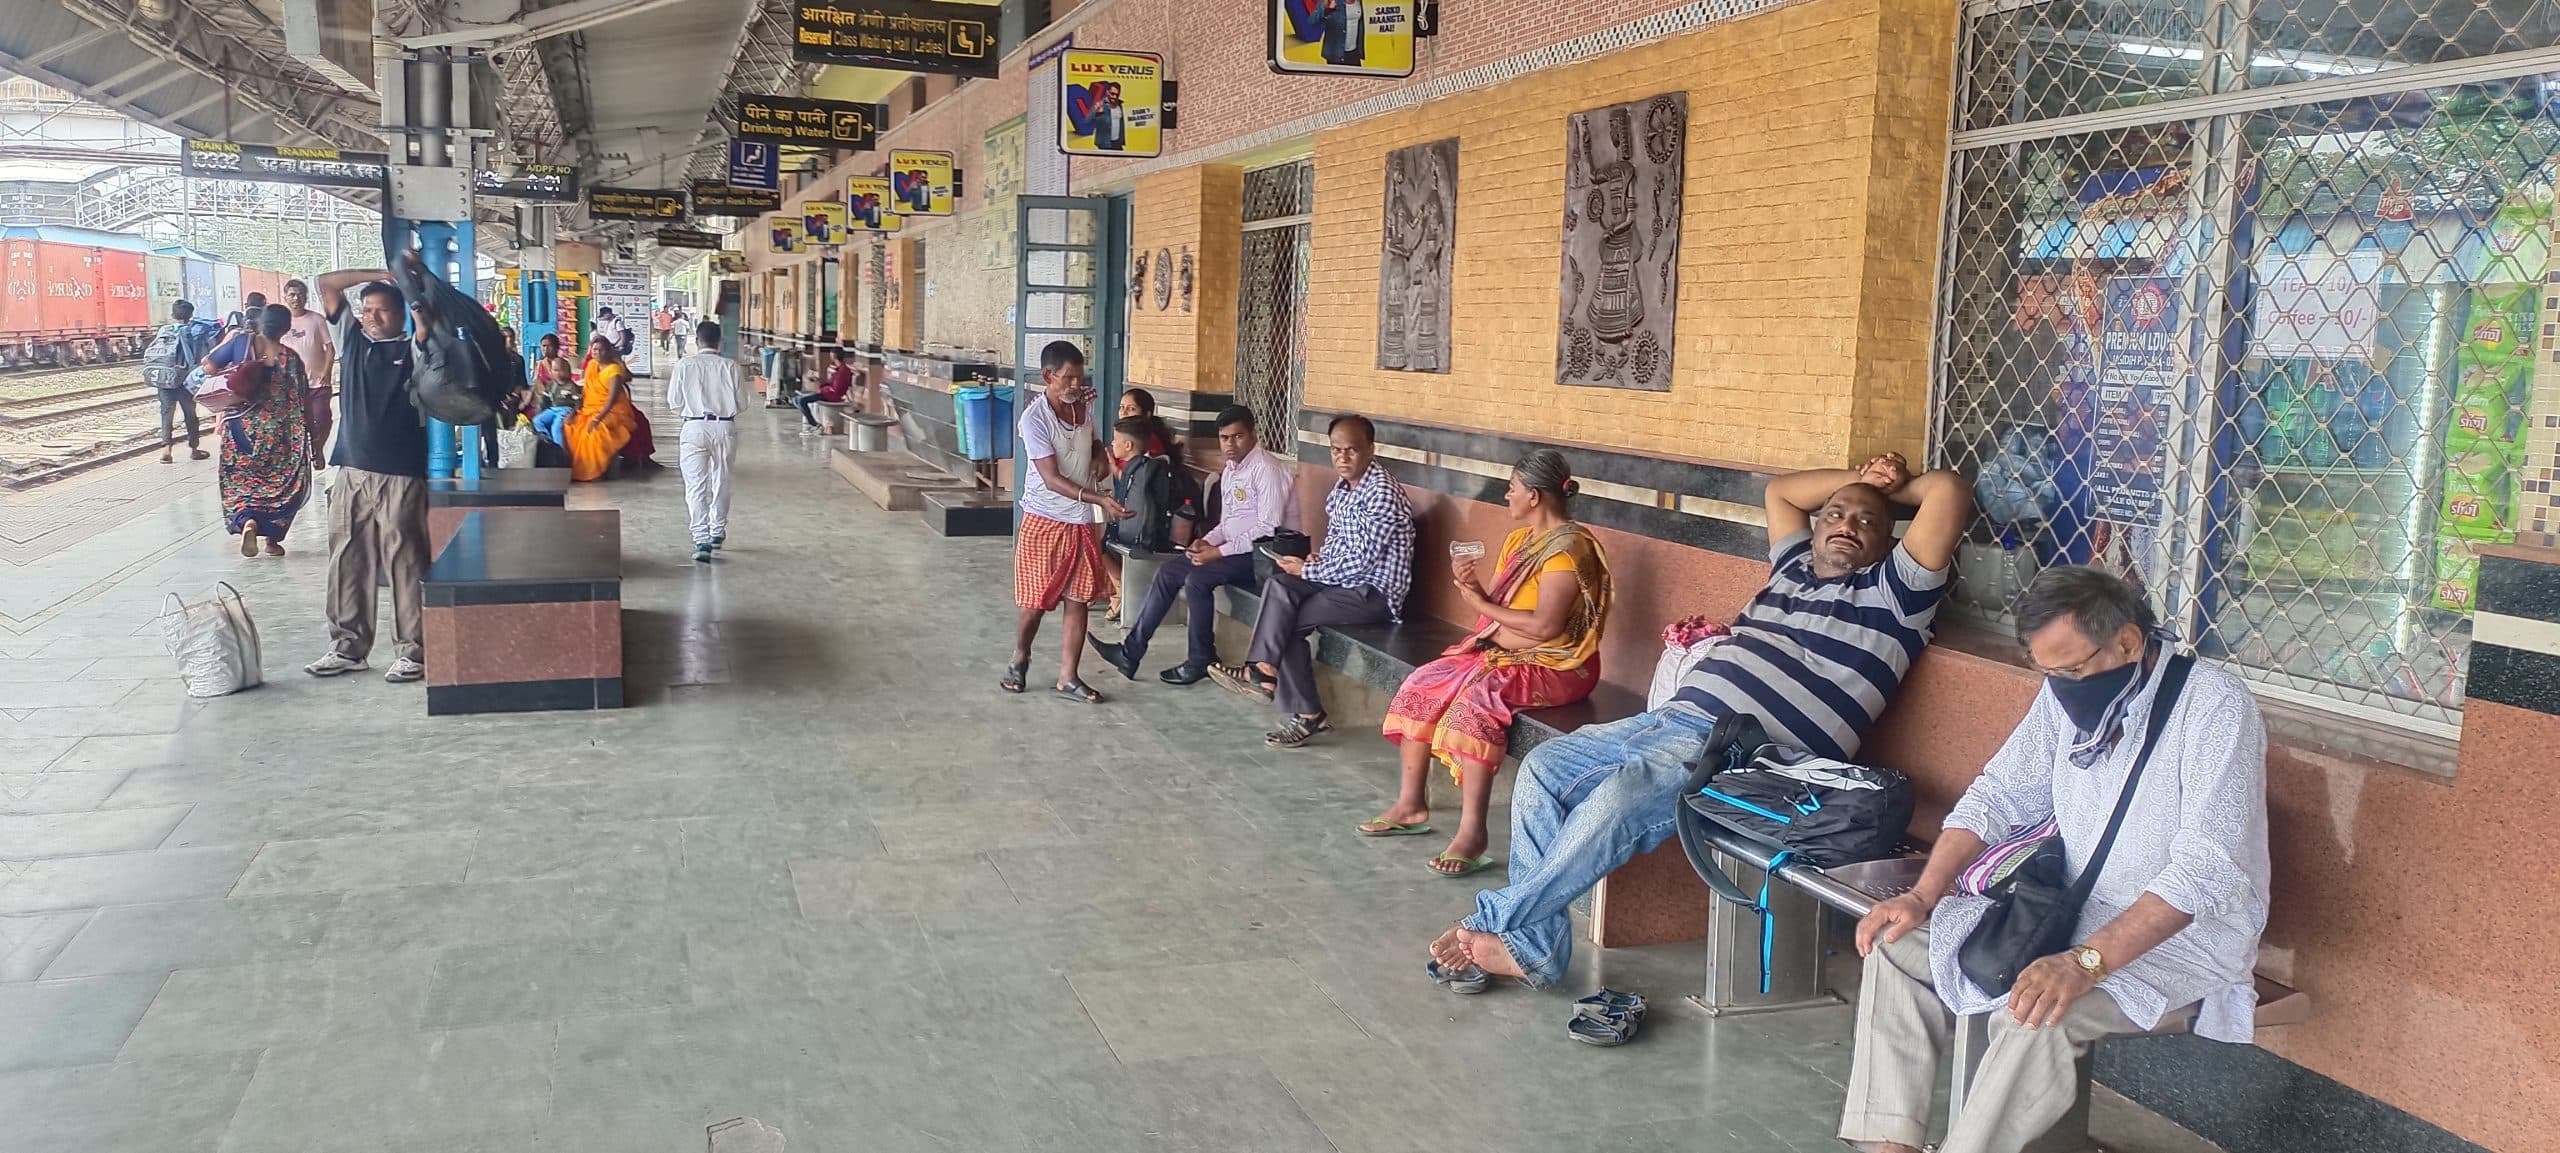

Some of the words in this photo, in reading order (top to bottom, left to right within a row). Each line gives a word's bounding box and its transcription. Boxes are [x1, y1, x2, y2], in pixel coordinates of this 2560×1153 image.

[801, 6, 856, 26] आरक्षित
[1369, 15, 1405, 24] MAANGTA
[799, 27, 832, 46] Reserved
[834, 30, 858, 47] Class
[859, 33, 892, 54] Waiting
[893, 38, 910, 52] Hall
[911, 38, 946, 57] (Ladies)
[1071, 63, 1105, 72] LUX
[1109, 64, 1154, 75] VENUS
[744, 103, 771, 120] पीने
[774, 108, 794, 122] का
[797, 108, 828, 124] पानी
[741, 122, 792, 138] Drinking
[795, 126, 831, 138] Water
[190, 140, 222, 151] TRAIN
[2280, 277, 2306, 292] TEA
[2106, 332, 2146, 350] PREMIUM
[2106, 390, 2122, 398] ITEM
